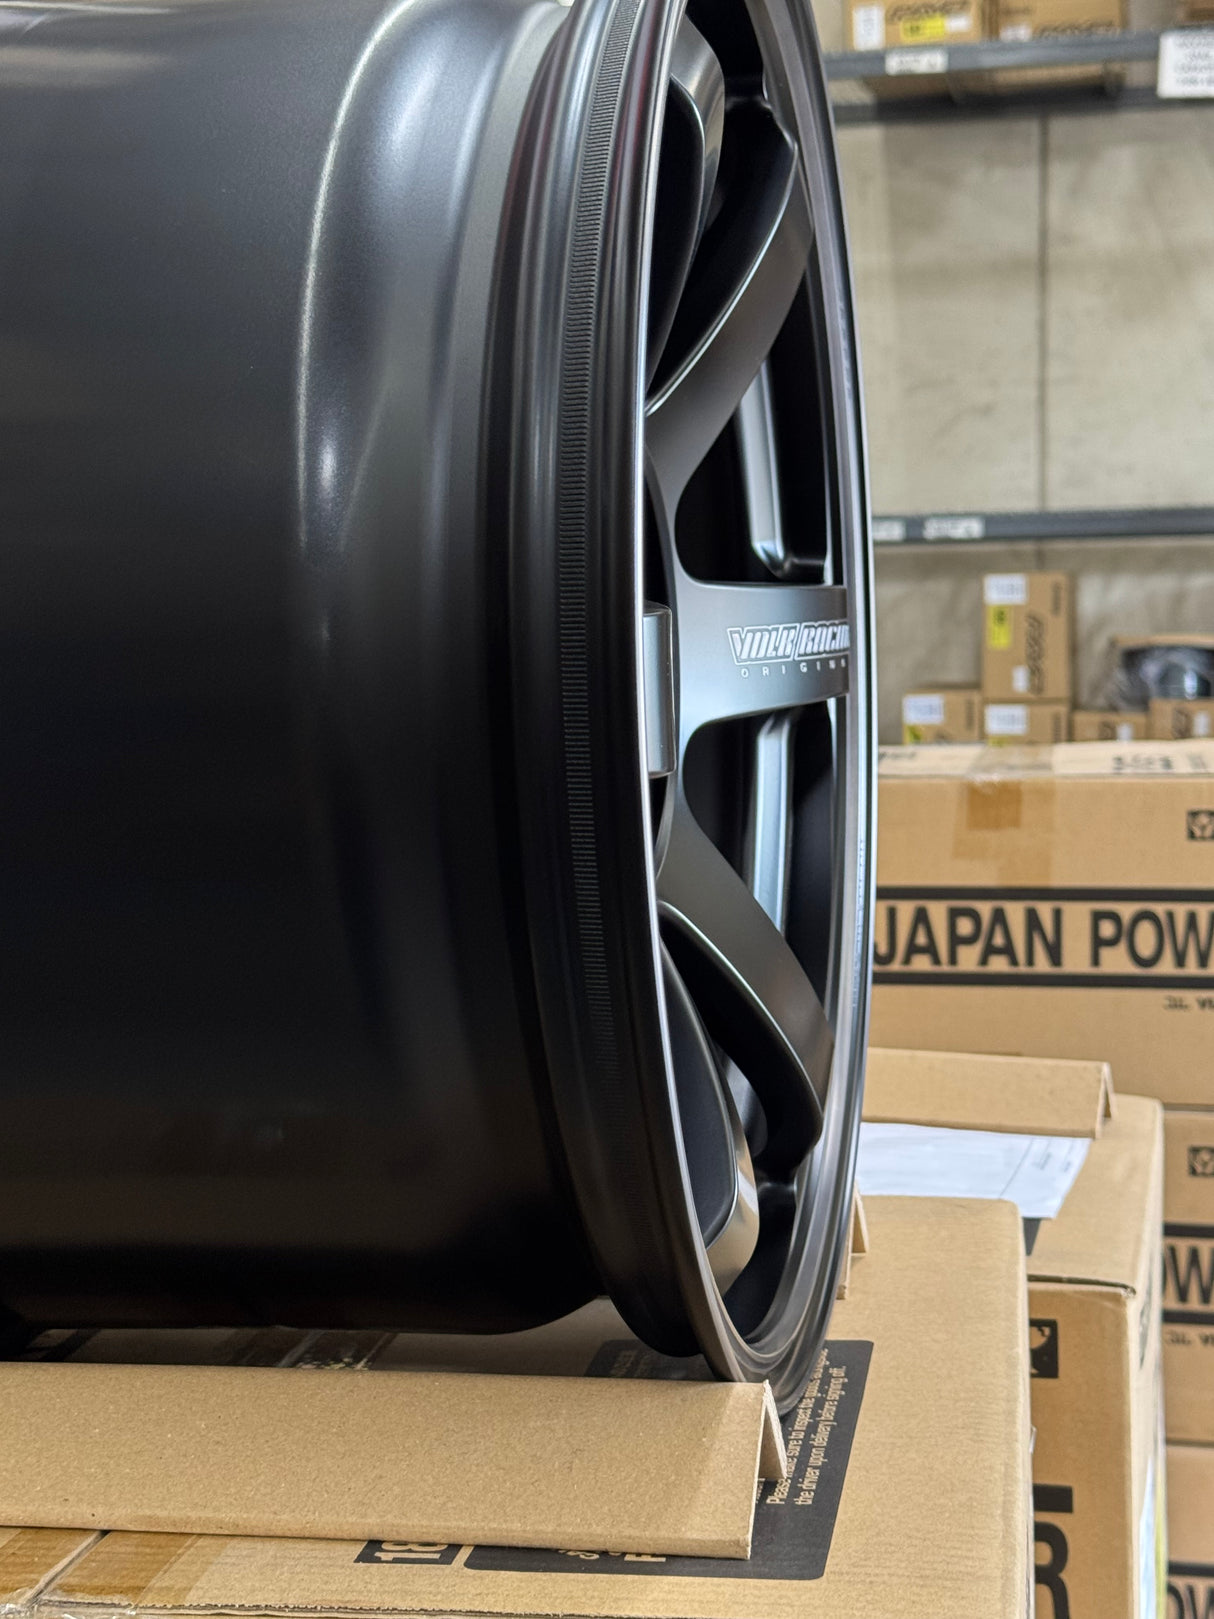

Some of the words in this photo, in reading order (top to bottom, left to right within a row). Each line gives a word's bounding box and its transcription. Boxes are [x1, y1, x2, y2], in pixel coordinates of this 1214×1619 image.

[731, 628, 797, 661] VOLK
[873, 905, 1063, 968] JAPAN
[809, 1420, 837, 1447] delivery
[808, 1447, 828, 1466] upon
[797, 1467, 820, 1490] driver
[793, 1491, 815, 1505] the
